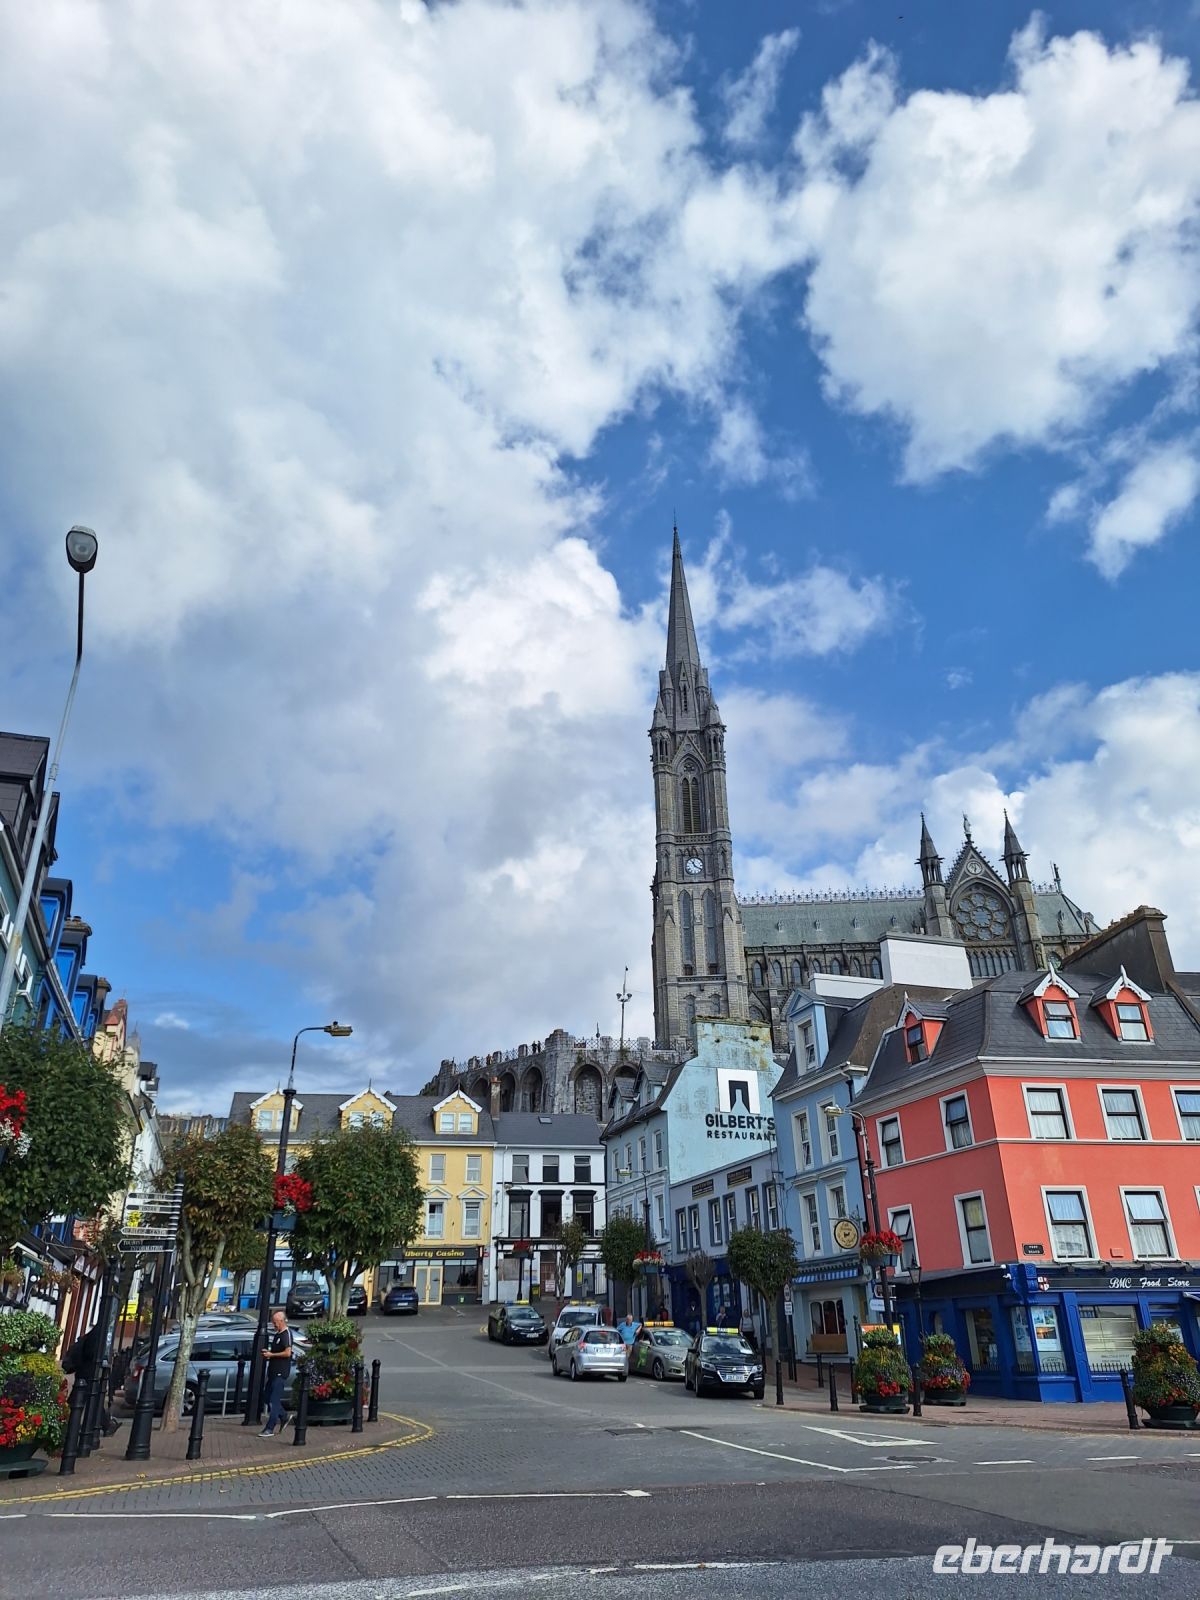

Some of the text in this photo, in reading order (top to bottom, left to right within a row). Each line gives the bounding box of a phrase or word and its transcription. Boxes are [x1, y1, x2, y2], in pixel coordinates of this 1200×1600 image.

[705, 1113, 776, 1130] GILBERT'S
[707, 1130, 777, 1141] RESTAURANT
[436, 1249, 465, 1257] Casino
[1139, 1277, 1161, 1288] Food
[1167, 1277, 1190, 1287] Store
